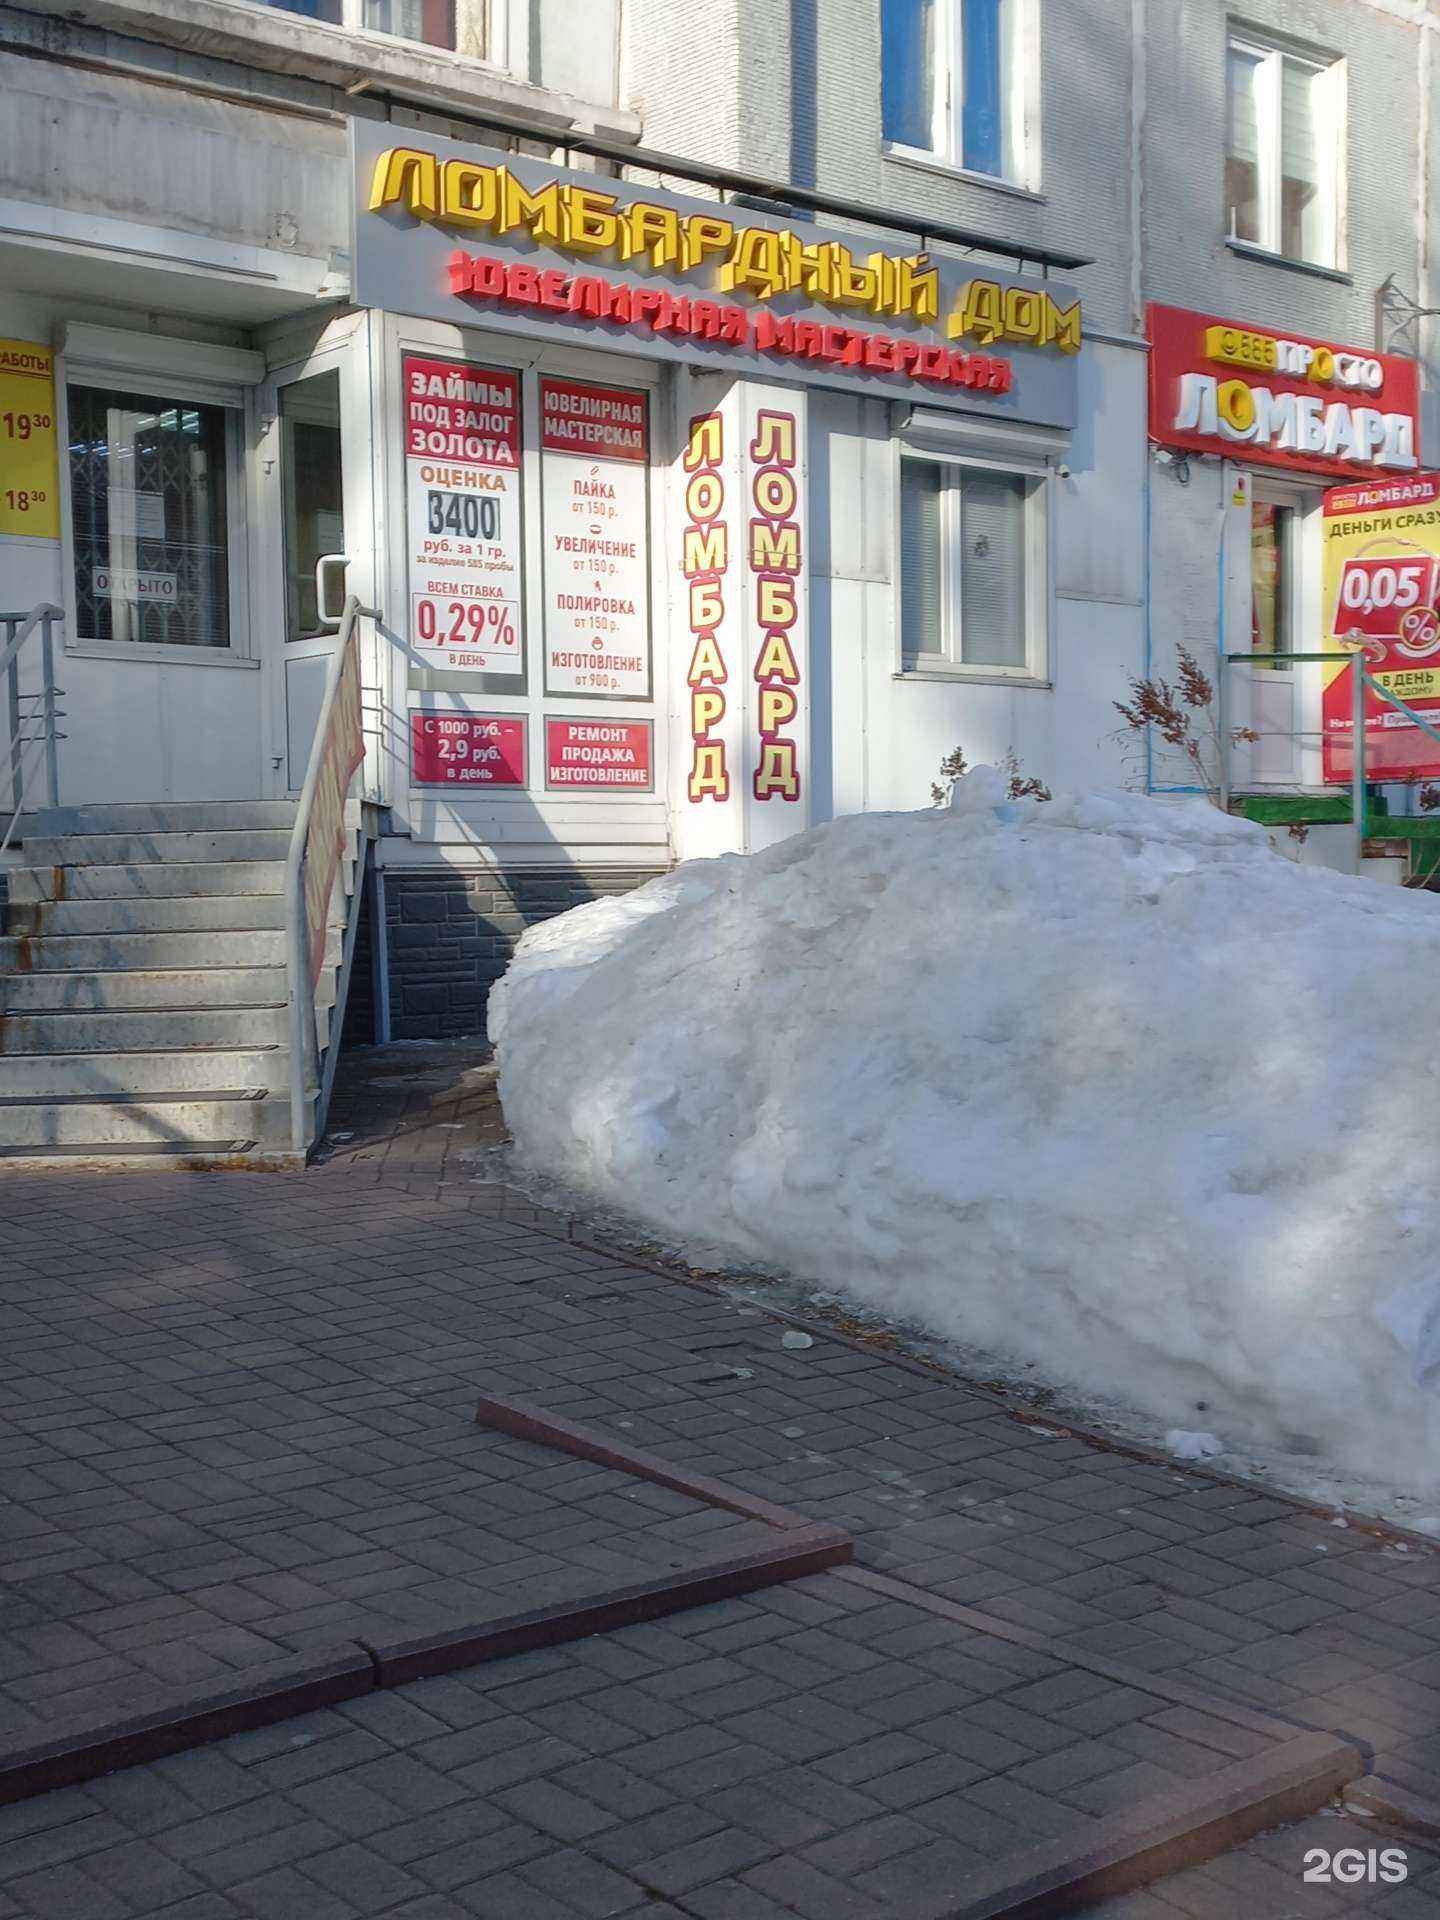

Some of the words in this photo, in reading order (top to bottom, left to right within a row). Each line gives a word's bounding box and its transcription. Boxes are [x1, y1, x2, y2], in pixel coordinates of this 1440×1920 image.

[369, 147, 939, 326] ЛОМБАРДНЫЙ
[948, 279, 1082, 350] ДОМ
[446, 250, 748, 347] ЮВЕЛИРНАЯ
[756, 309, 1013, 394] МАСТЕРСКАЯ
[0, 352, 49, 371] АБОТЫ
[411, 372, 512, 408] ЗАЙМЫ
[410, 401, 450, 428] ПОД
[455, 407, 514, 433] ЗАЛОГ
[544, 391, 642, 423] ЮВЕЛИРНАЯ
[1175, 373, 1418, 468] ЛОМБАРД
[544, 417, 642, 448] МАСТЕРСКАЯ
[412, 429, 514, 464] ЗОЛОТА
[420, 466, 507, 491] ОЦЕНКА
[573, 479, 616, 499] ПАЙКА
[1357, 483, 1434, 506] ЛОМБАРД
[429, 492, 497, 540] 3400
[572, 502, 584, 512] от
[588, 502, 606, 517] 150
[1329, 517, 1392, 538] ДЕНЬГИ
[424, 539, 452, 553] руб.
[457, 544, 472, 554] за
[477, 544, 483, 555] 1
[488, 547, 506, 560] гр.
[555, 535, 636, 558] УВЕЛИЧЕНИЕ
[573, 560, 584, 570] от
[588, 559, 606, 572] 150
[428, 581, 459, 594] ВСЕМ
[461, 583, 504, 598] СТАВКА
[1343, 566, 1422, 615] 0,05
[557, 594, 635, 615] ПОЛИРОВКА
[683, 410, 729, 803] ЛОМБАРД
[749, 408, 801, 802] ЛОМБАРД
[418, 600, 514, 647] 0,29%
[574, 617, 586, 628] от
[590, 616, 607, 630] 150
[449, 654, 456, 665] В
[456, 655, 486, 667] ДЕНЬ
[552, 651, 643, 672] ИЗГОТОВЛЕНИЕ
[575, 676, 587, 686] от
[1394, 671, 1434, 687] ДЕНЬ
[425, 721, 435, 733] С
[438, 721, 469, 735] 1000
[473, 722, 502, 737] руб.
[568, 727, 629, 742] РЕМОНТ
[438, 739, 469, 761] 2,9
[473, 748, 502, 762] руб.
[562, 746, 635, 764] ПРОДАЖА
[447, 768, 456, 778] в
[461, 768, 493, 780] день
[550, 767, 647, 783] ИЗГОТОВЛЕНИЕ
